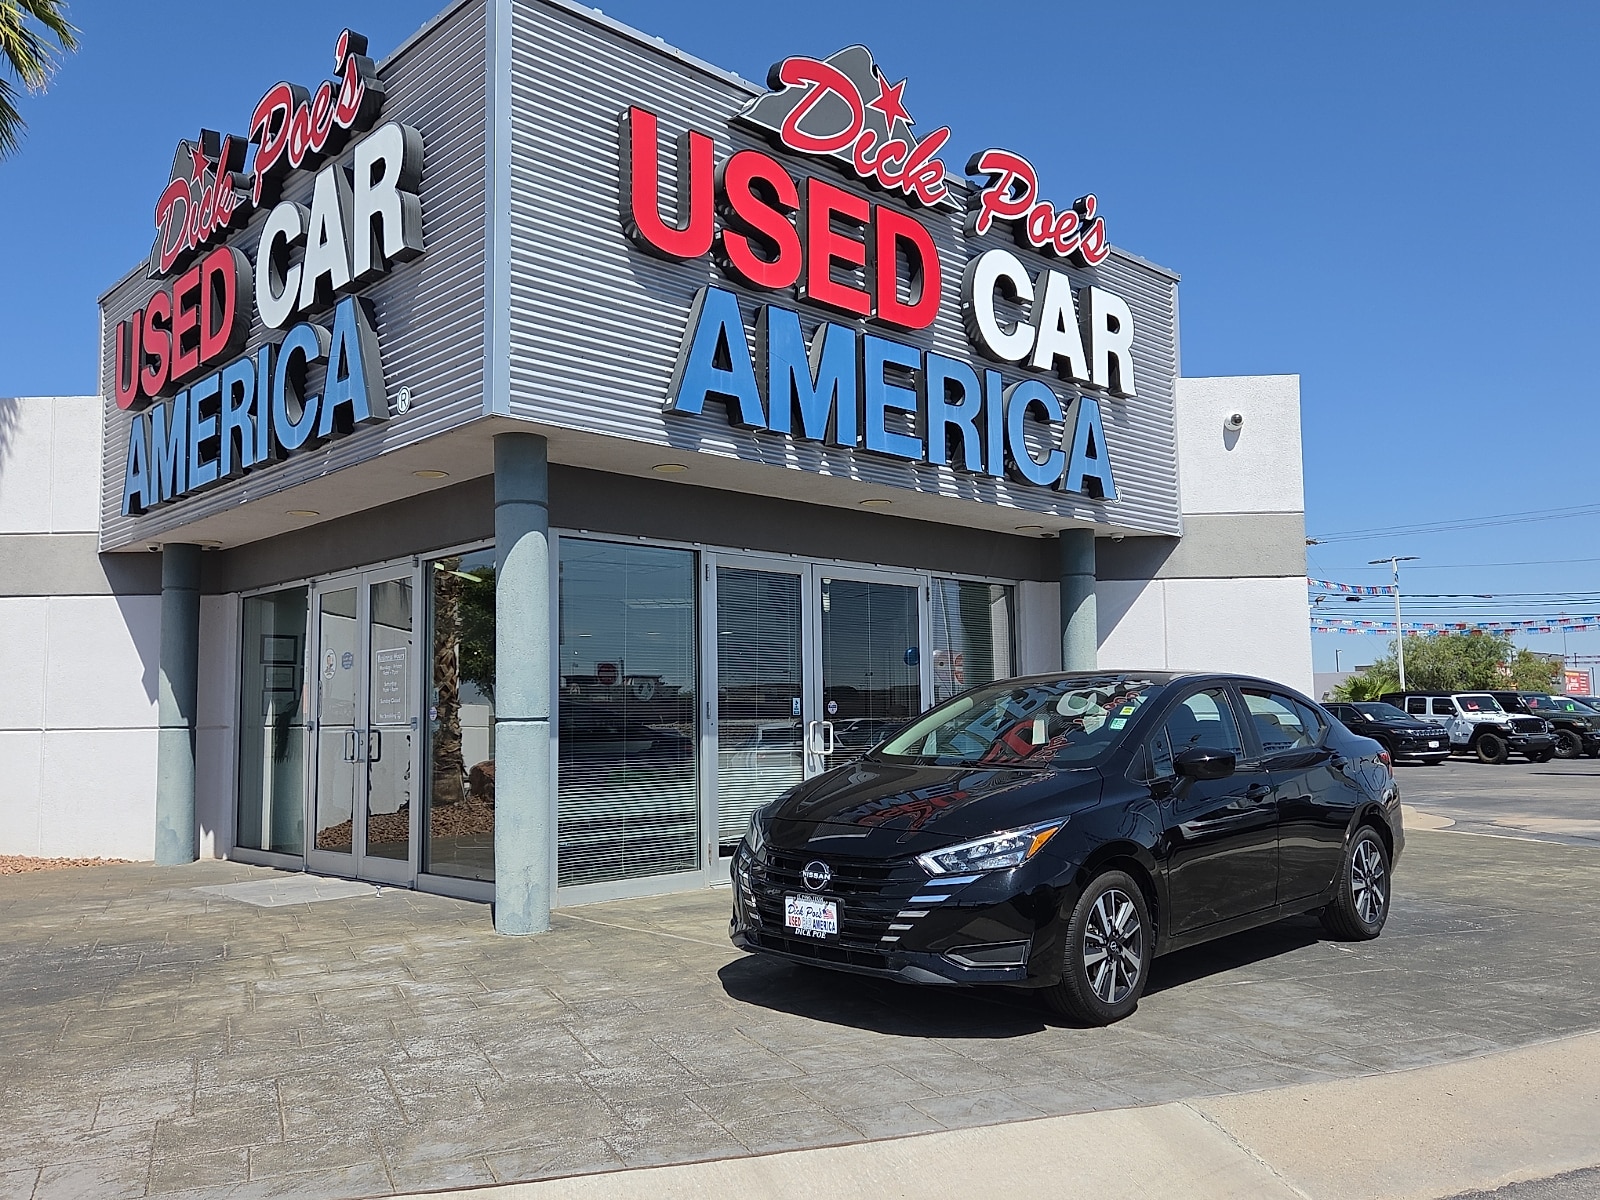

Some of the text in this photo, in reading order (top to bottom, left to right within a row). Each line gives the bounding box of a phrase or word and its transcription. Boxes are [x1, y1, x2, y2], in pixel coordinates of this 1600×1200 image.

[155, 28, 366, 275] Dick Poe's
[630, 106, 1137, 397] USED CAR
[779, 56, 1111, 267] Dick Poe's
[115, 121, 407, 410] USED CAR
[120, 295, 372, 516] AMERICA
[674, 285, 1117, 499] AMERICA
[788, 916, 801, 926] USED
[813, 919, 835, 932] AMERICA
[795, 928, 827, 939] DICK POE
[802, 870, 831, 881] NISSAN
